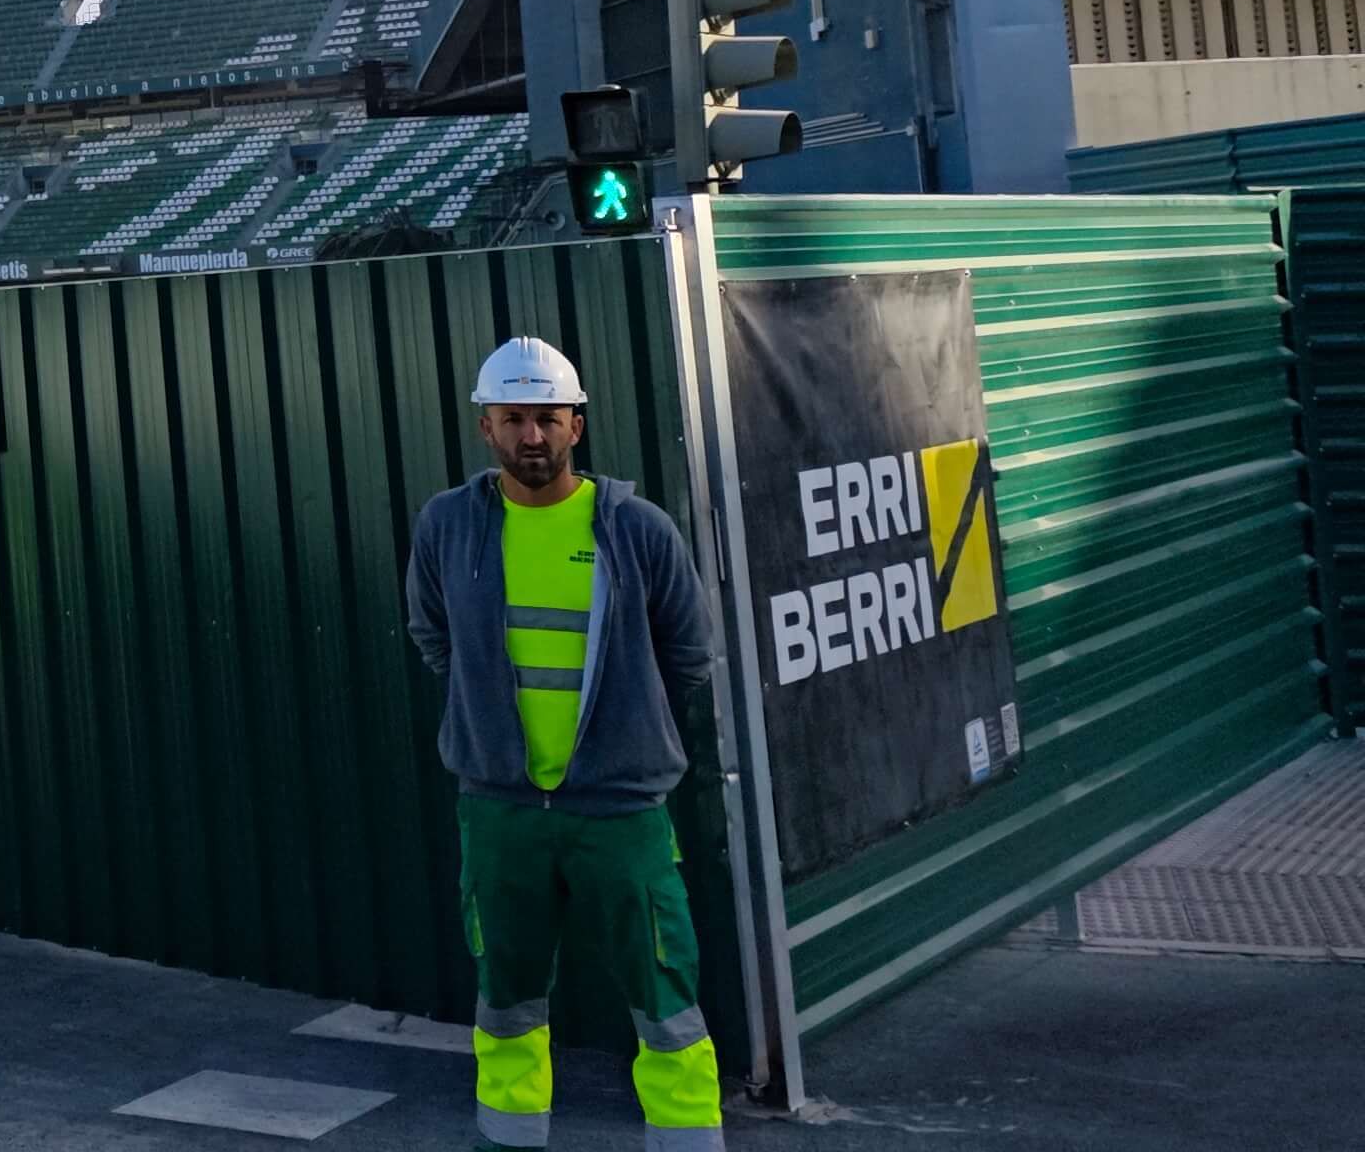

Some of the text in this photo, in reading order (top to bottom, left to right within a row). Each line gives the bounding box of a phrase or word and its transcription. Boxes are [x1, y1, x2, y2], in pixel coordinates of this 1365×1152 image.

[27, 83, 118, 102] abuelos
[141, 81, 149, 92] a
[275, 64, 316, 78] una
[139, 248, 248, 273] Manquepierda
[798, 451, 922, 558] ERRI
[770, 557, 936, 686] BERRI
